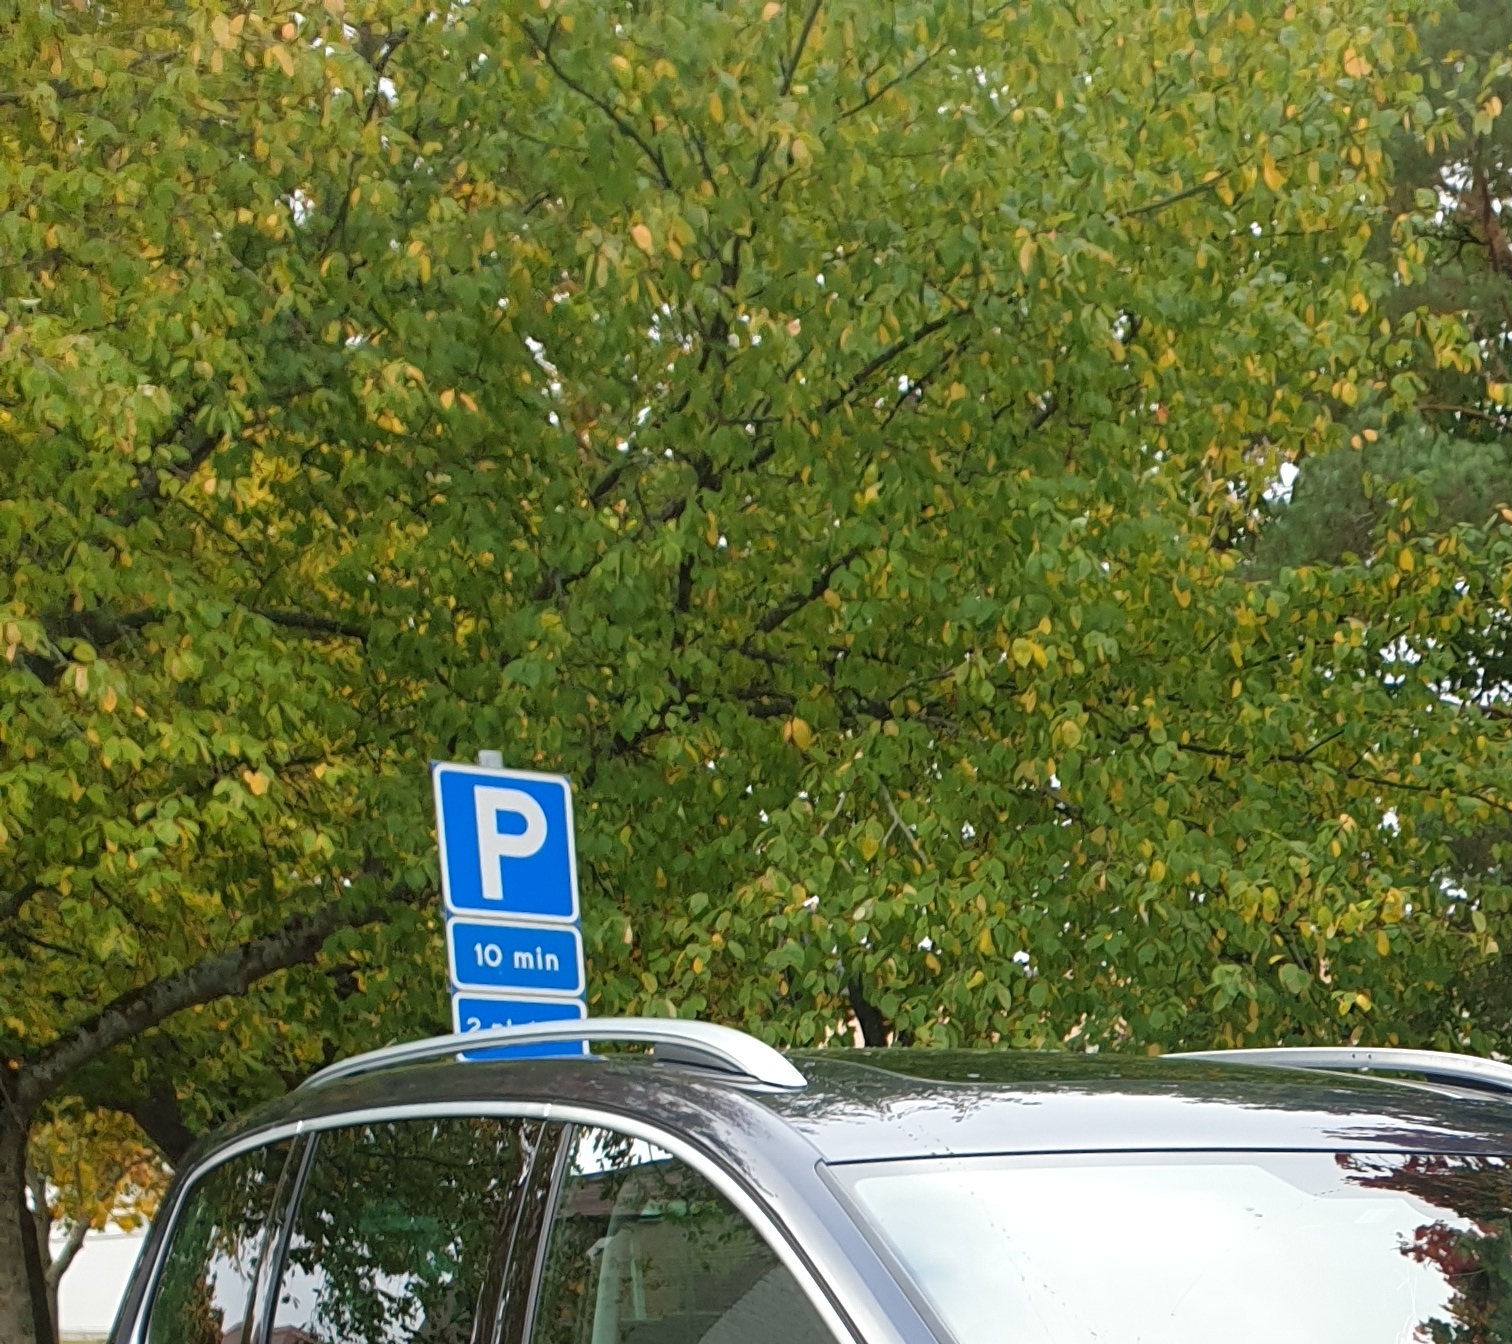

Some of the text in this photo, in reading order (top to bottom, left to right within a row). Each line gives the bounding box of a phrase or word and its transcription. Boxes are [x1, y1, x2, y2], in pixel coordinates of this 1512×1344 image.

[473, 784, 548, 900] P
[473, 942, 559, 972] 10 min
